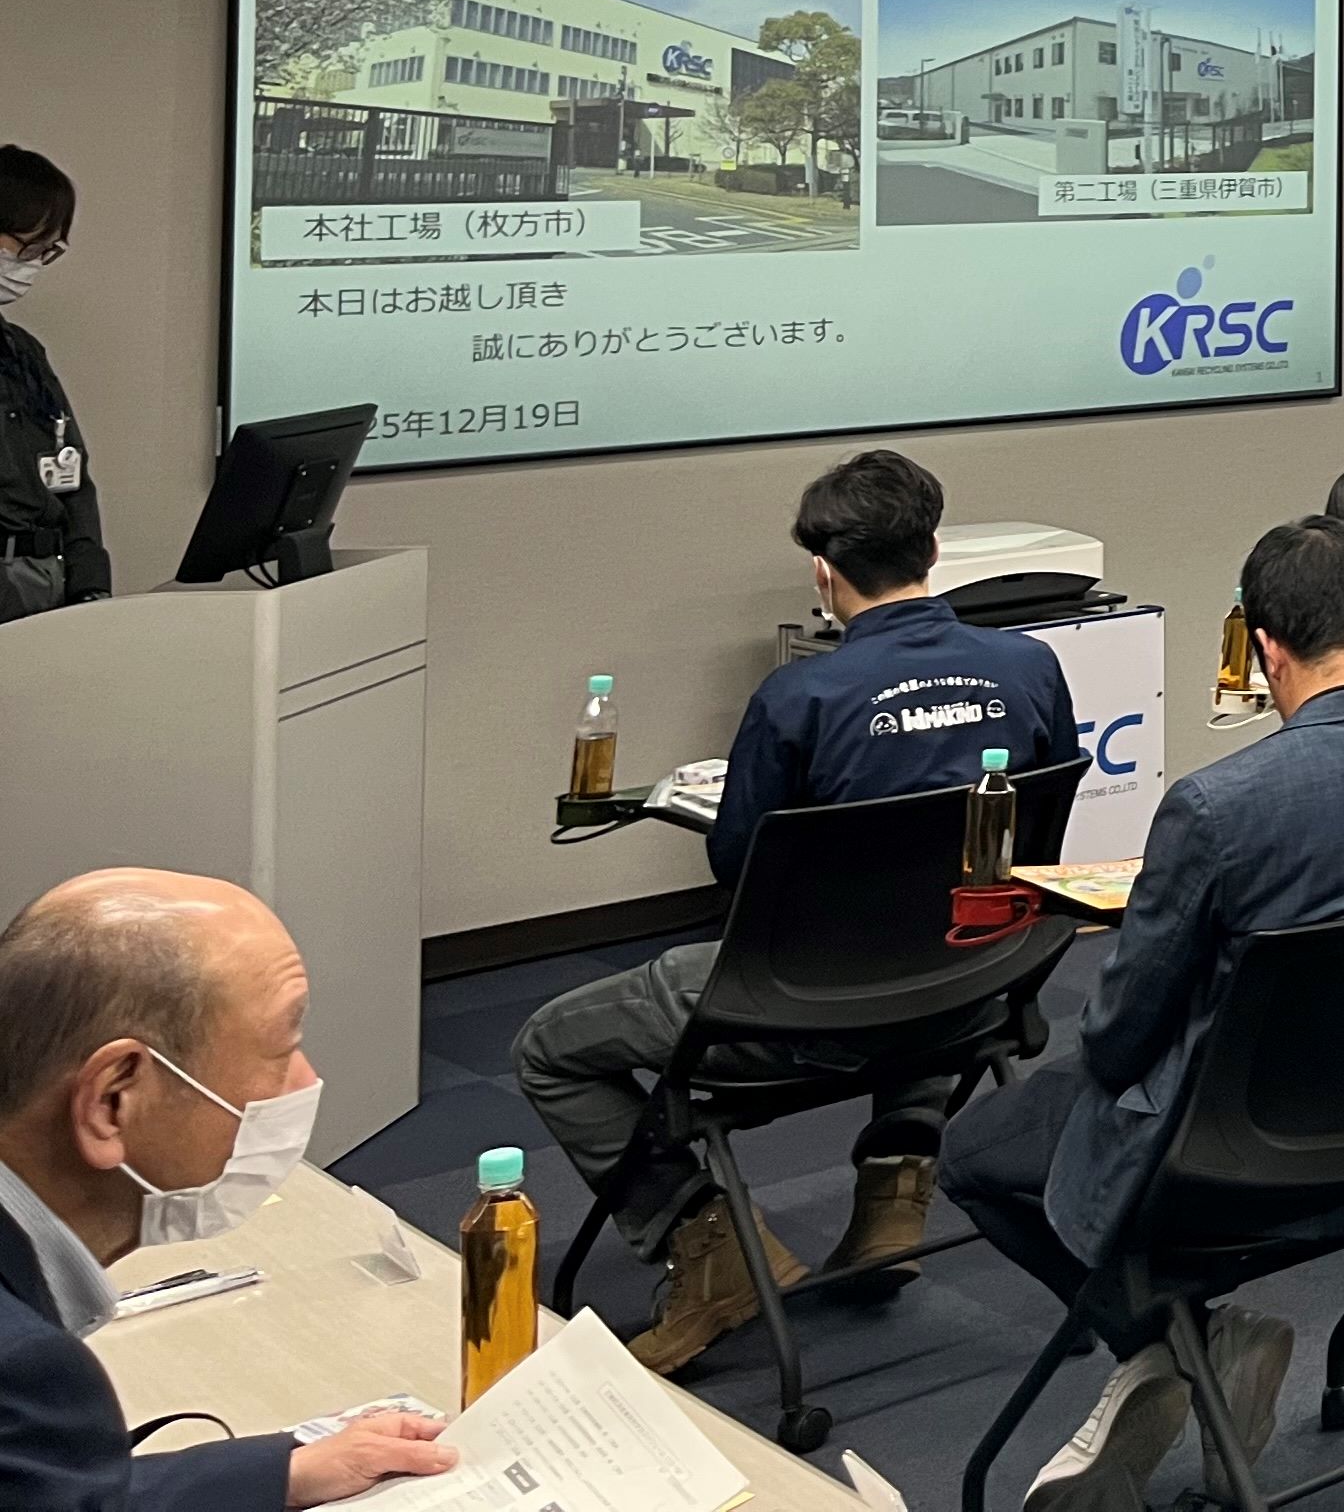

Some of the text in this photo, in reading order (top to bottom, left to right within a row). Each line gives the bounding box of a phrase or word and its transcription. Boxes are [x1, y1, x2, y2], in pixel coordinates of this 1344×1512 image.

[298, 281, 569, 318] 本日はお越し頂き
[473, 316, 847, 364] 誠にありがとうございます。
[1120, 295, 1293, 374] KRSC
